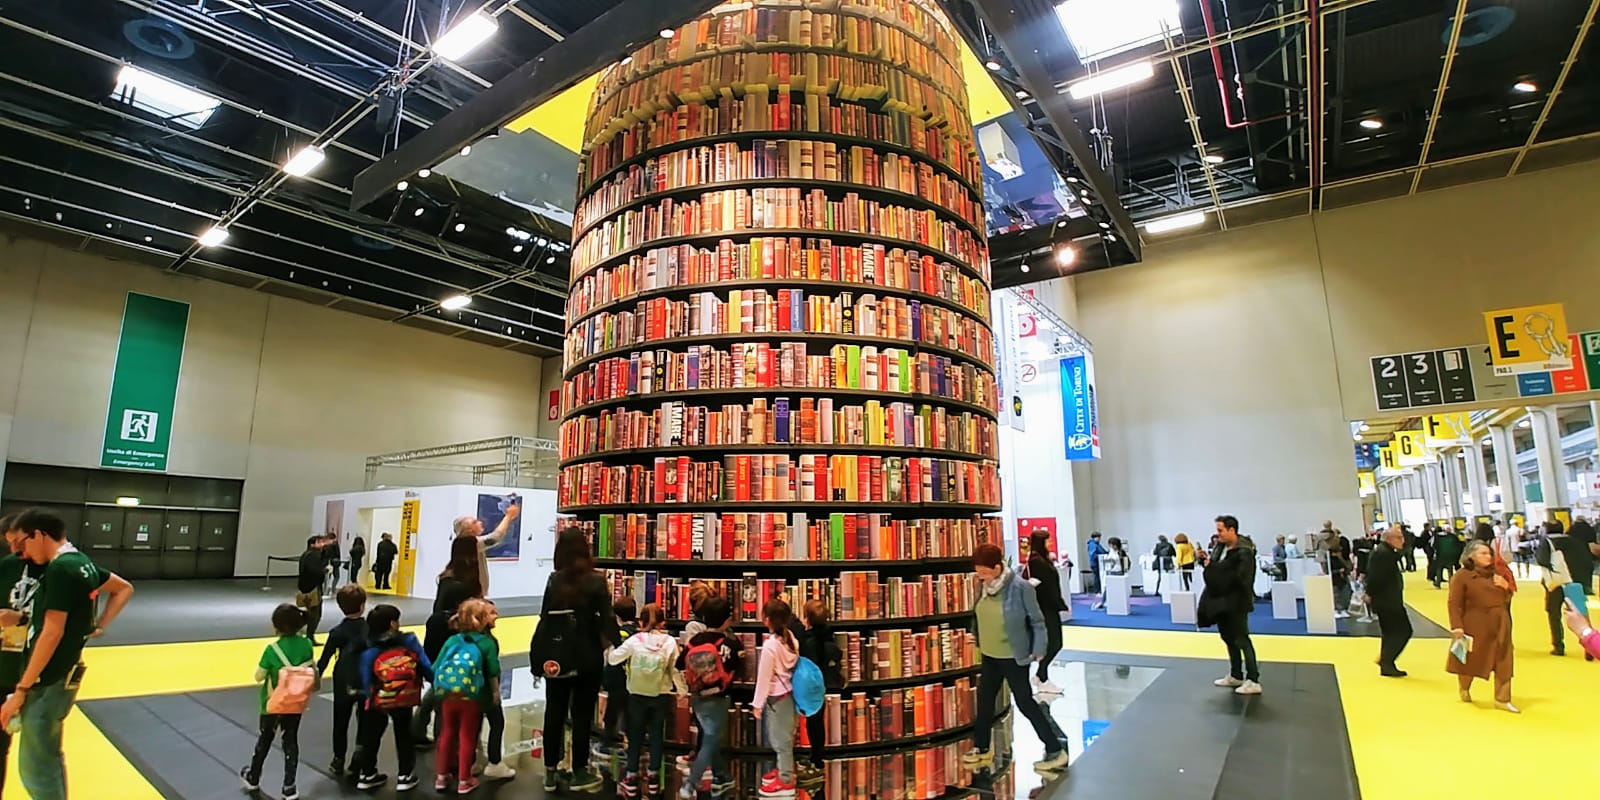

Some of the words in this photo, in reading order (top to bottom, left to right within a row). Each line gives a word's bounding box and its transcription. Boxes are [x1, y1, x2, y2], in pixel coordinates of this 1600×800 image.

[863, 248, 875, 279] MARE
[1494, 315, 1520, 359] E
[1380, 358, 1398, 378] 2
[1411, 354, 1429, 375] 3
[671, 407, 682, 440] MARE
[1383, 450, 1394, 468] H
[1401, 435, 1412, 455] G
[691, 518, 704, 553] MARE
[941, 629, 952, 663] MARE
